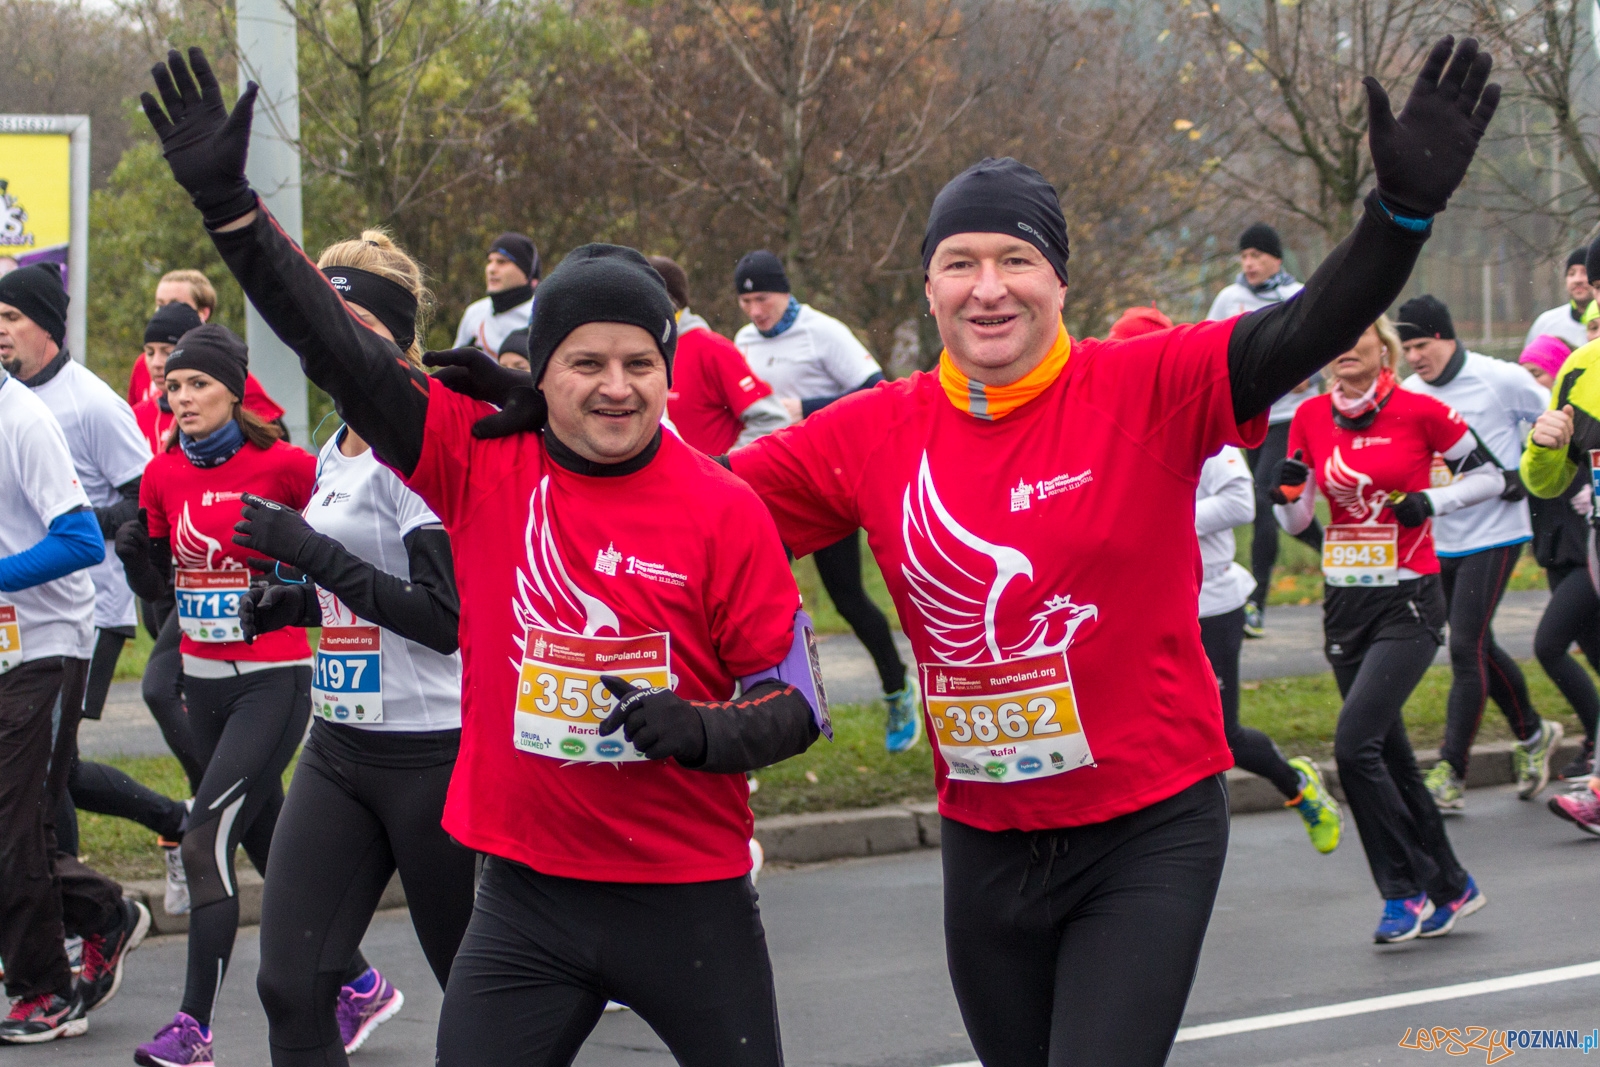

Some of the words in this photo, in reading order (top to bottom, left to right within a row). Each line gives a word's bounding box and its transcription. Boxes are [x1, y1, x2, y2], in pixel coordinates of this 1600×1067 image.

[1036, 481, 1047, 500] 1
[1332, 546, 1386, 565] 9943
[625, 556, 635, 574] 1
[182, 593, 239, 617] 7713
[595, 650, 657, 662] RunPoland.org
[990, 667, 1056, 686] RunPoland.org
[522, 681, 531, 694] D
[935, 717, 944, 730] D
[945, 697, 1062, 743] 3862
[520, 731, 540, 741] GRUPA
[568, 725, 599, 736] Marci
[520, 739, 544, 750] LUXMED
